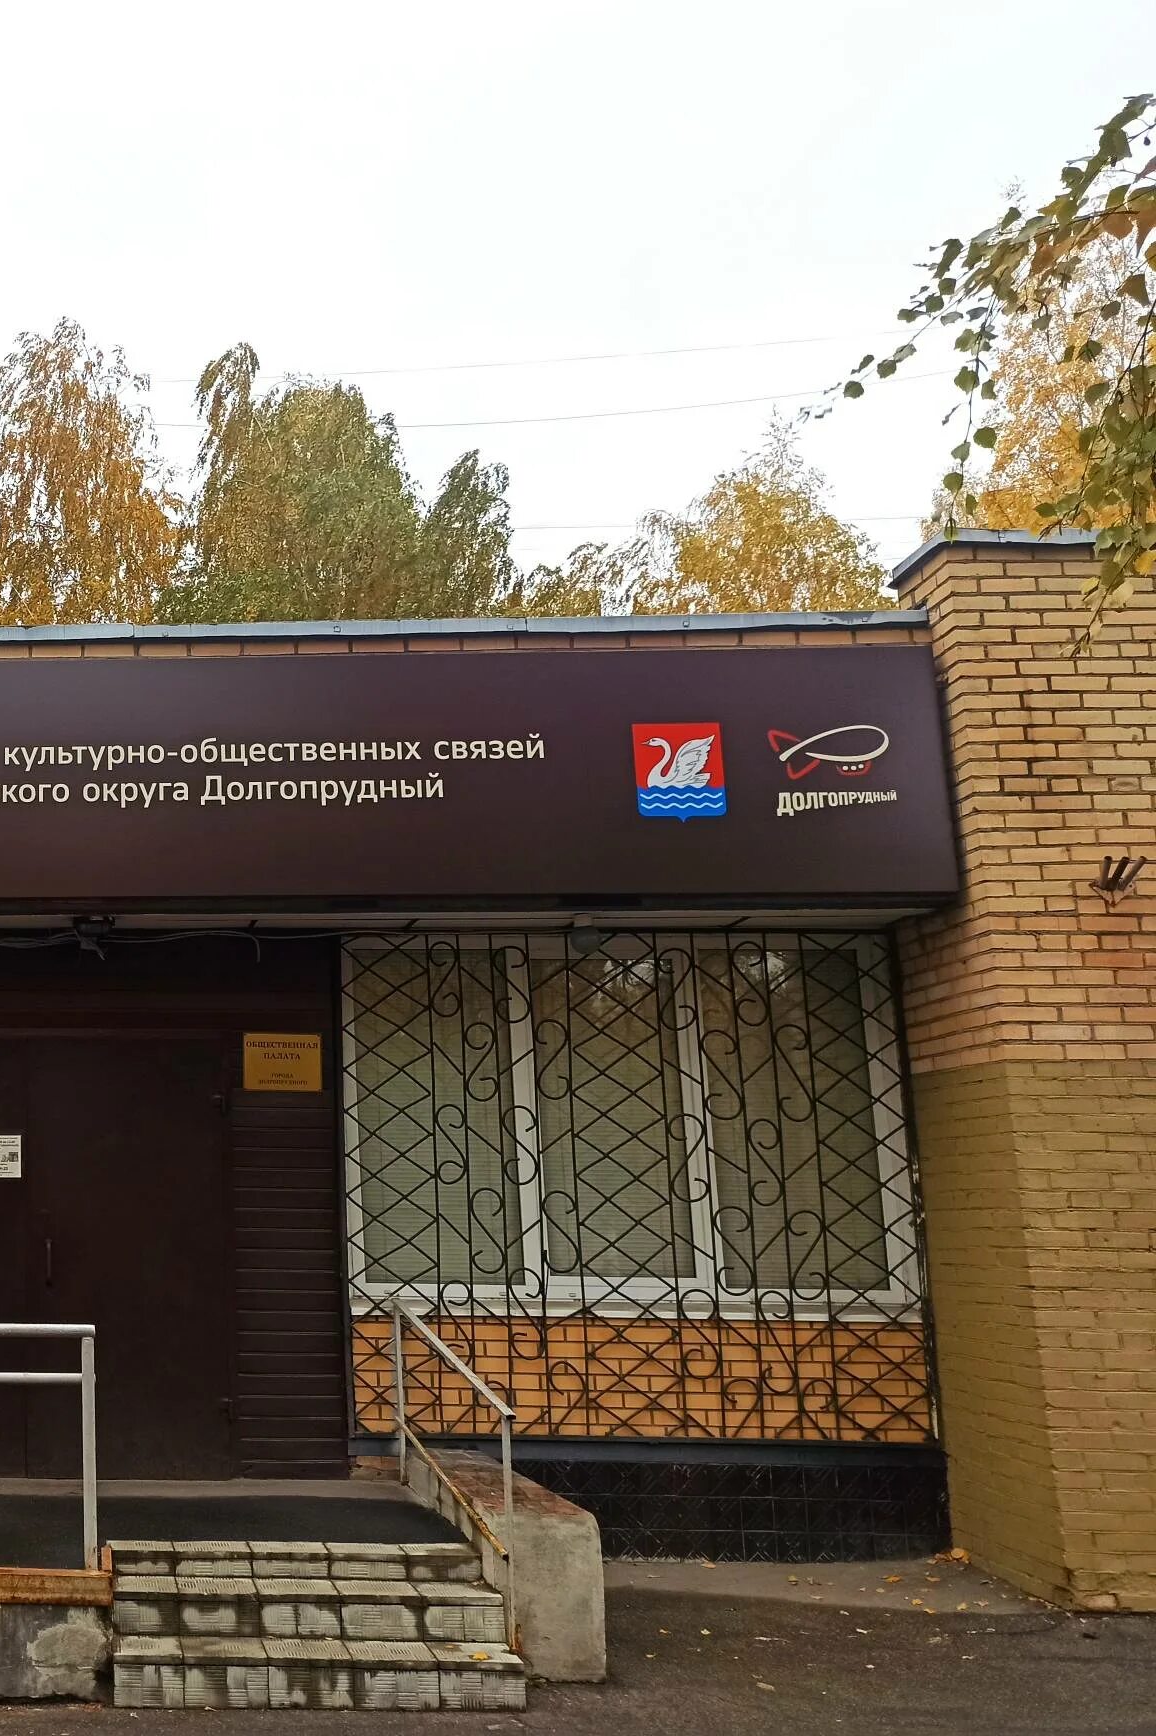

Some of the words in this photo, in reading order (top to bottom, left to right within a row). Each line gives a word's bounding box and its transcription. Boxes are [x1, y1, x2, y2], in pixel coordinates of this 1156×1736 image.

[3, 737, 422, 772] культурно-общественных
[433, 733, 546, 761] связей
[82, 780, 190, 809] округа
[200, 773, 445, 811] Долгопрудный
[776, 788, 898, 817] ДОЛГОПРУДНЫЙ
[246, 1041, 319, 1049] ОБЩЕСТВЕННАЯ
[264, 1052, 301, 1060] ПАЛАТА
